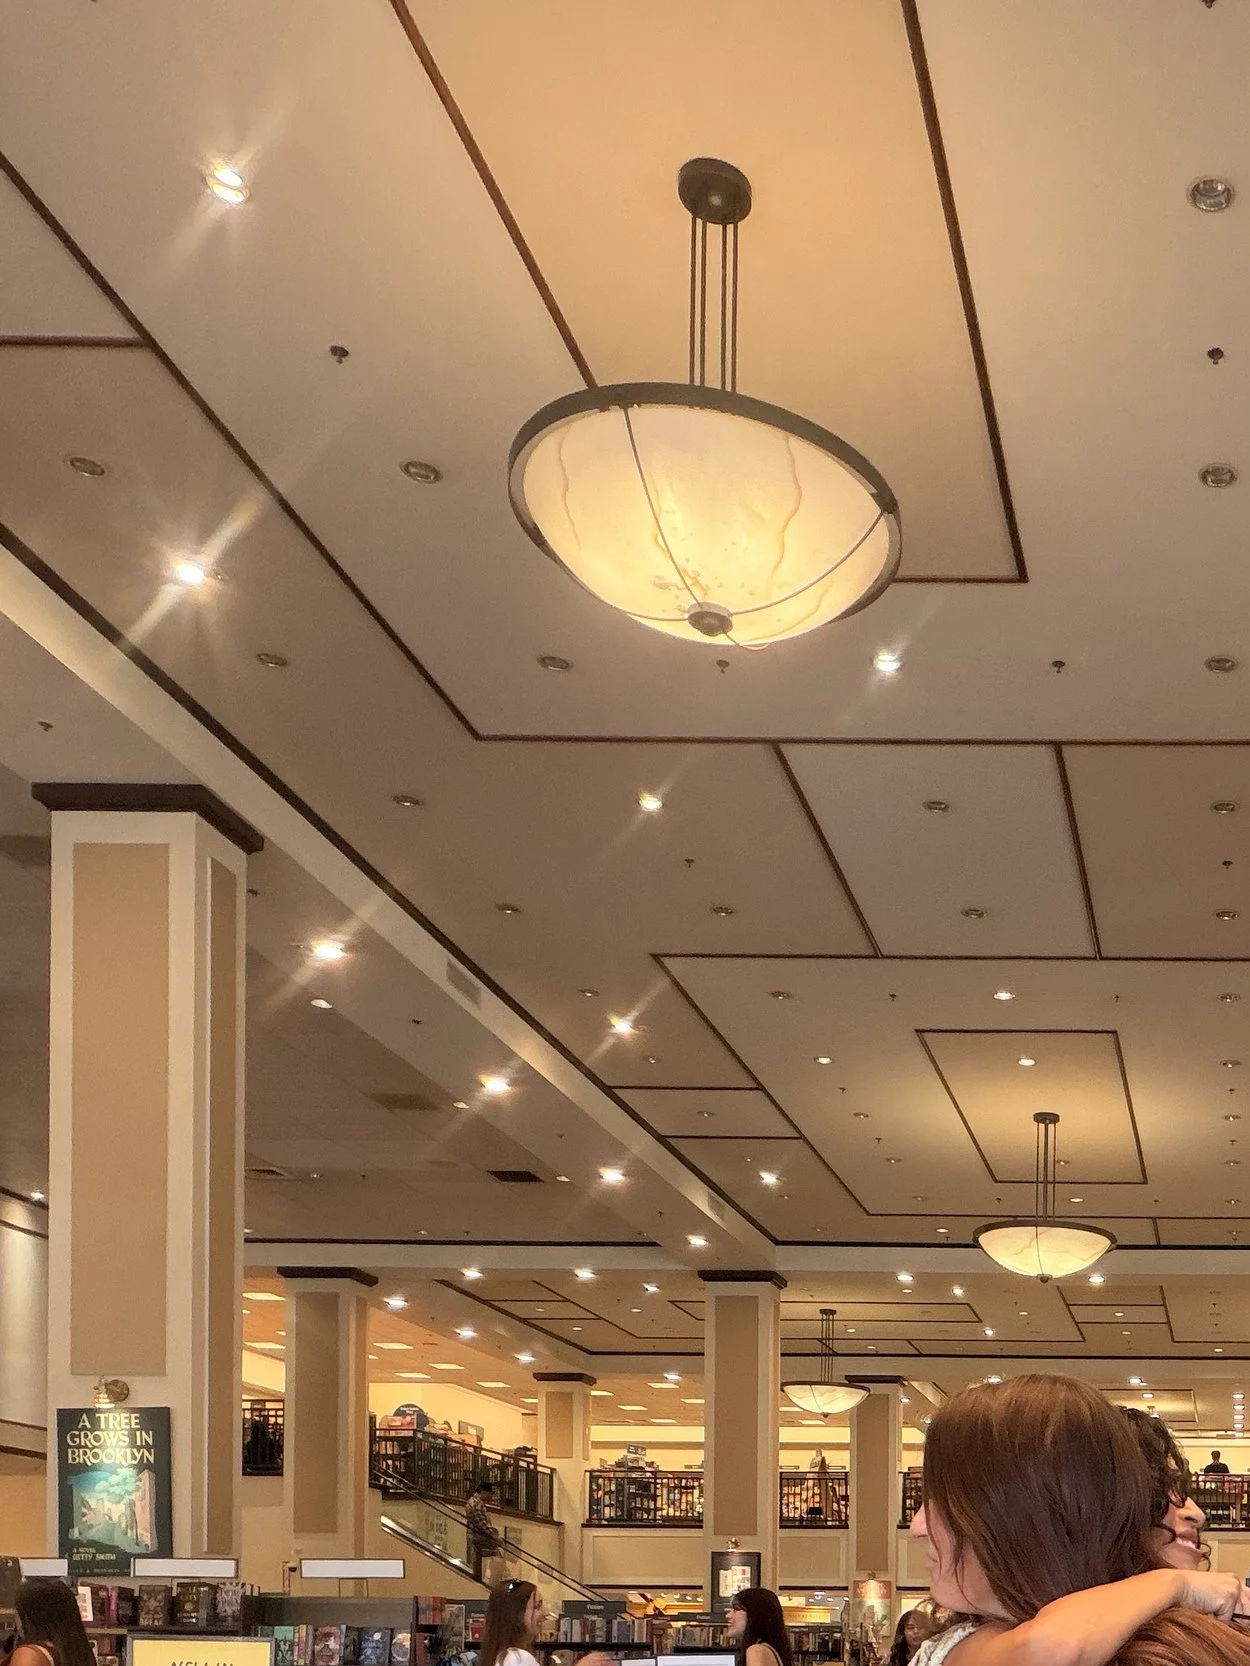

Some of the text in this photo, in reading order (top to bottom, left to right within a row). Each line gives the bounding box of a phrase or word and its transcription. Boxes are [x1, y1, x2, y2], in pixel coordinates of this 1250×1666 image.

[78, 1413, 140, 1429] A TREE
[67, 1431, 153, 1448] GROWS IN
[67, 1448, 154, 1466] BROOKLYN
